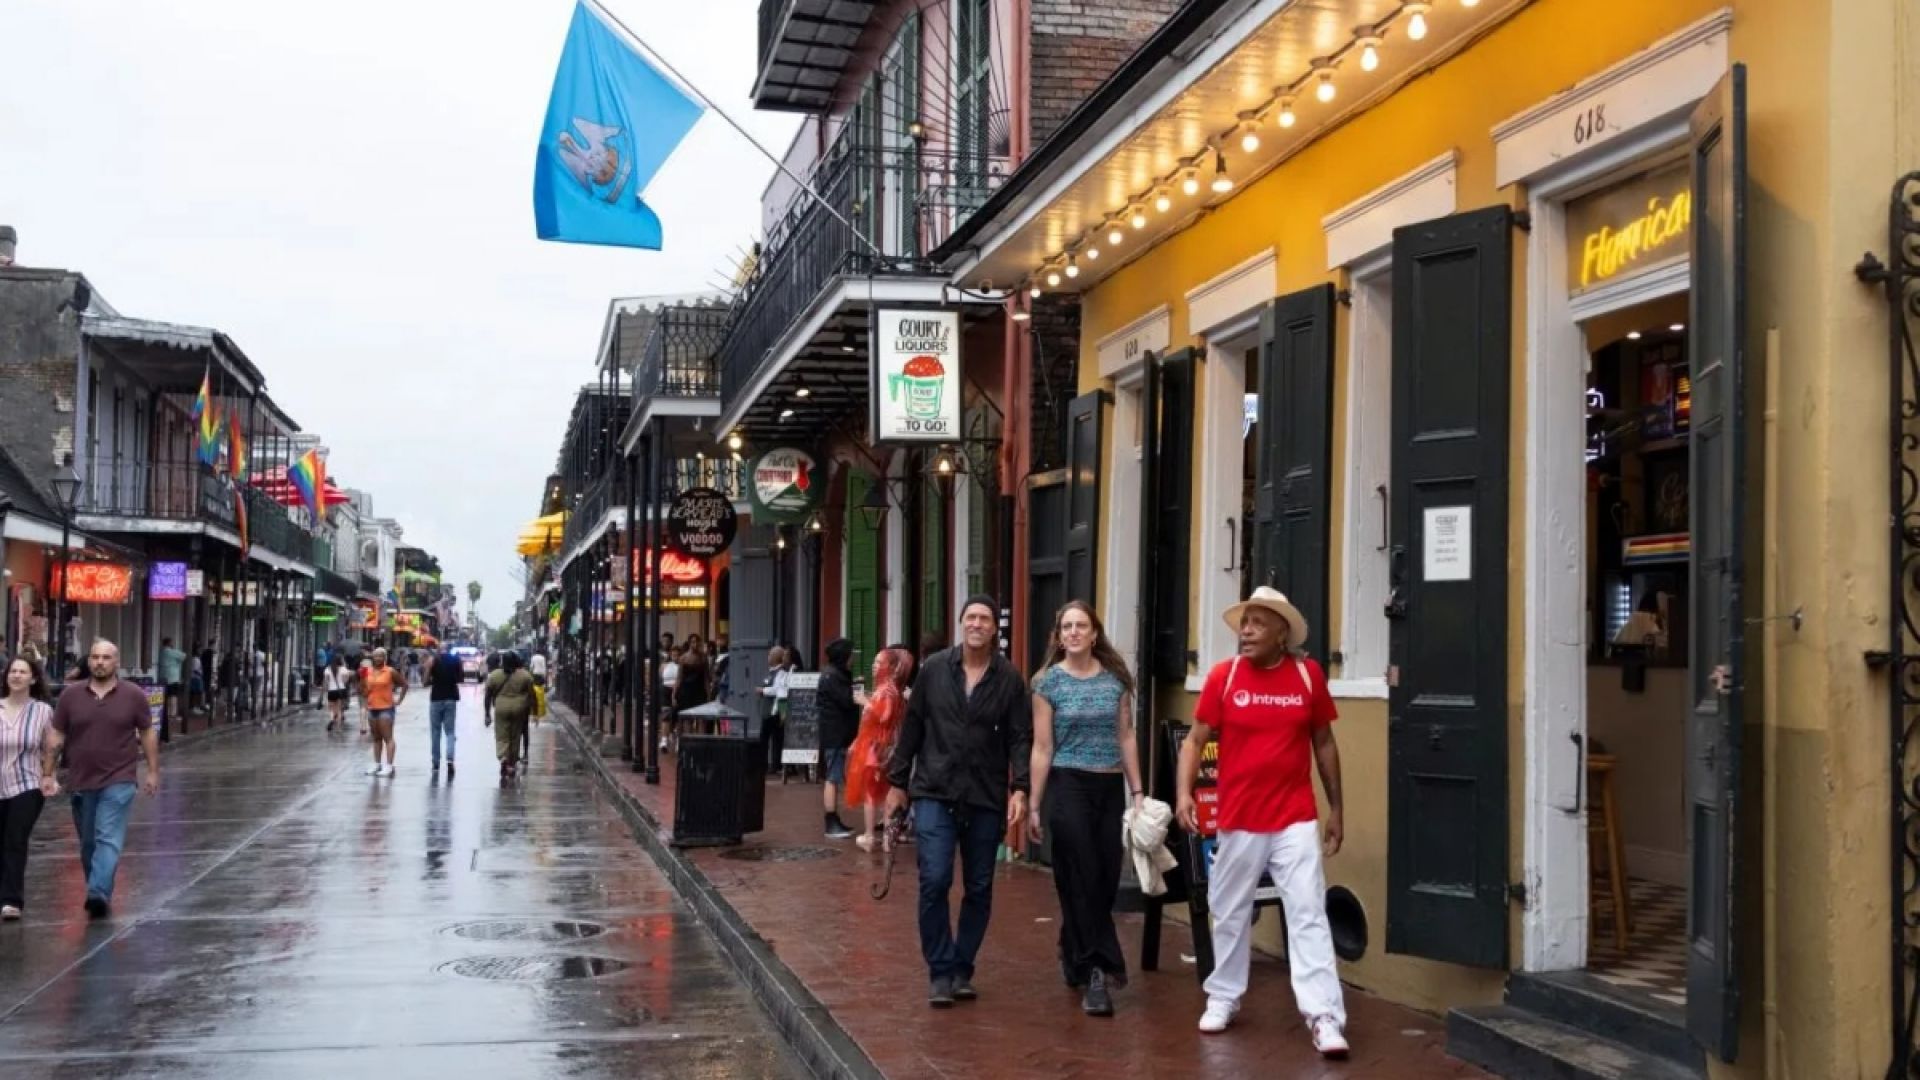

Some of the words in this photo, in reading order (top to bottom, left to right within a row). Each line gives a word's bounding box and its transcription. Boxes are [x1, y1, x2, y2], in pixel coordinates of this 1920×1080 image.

[1574, 103, 1606, 144] 618
[1581, 188, 1691, 288] Hurrica
[898, 318, 942, 338] COURT
[895, 339, 948, 352] LIQUORS
[924, 420, 947, 432] GO!
[686, 519, 718, 528] HOUSE
[679, 532, 724, 546] VOODOO
[1252, 692, 1304, 708] Intrepid
